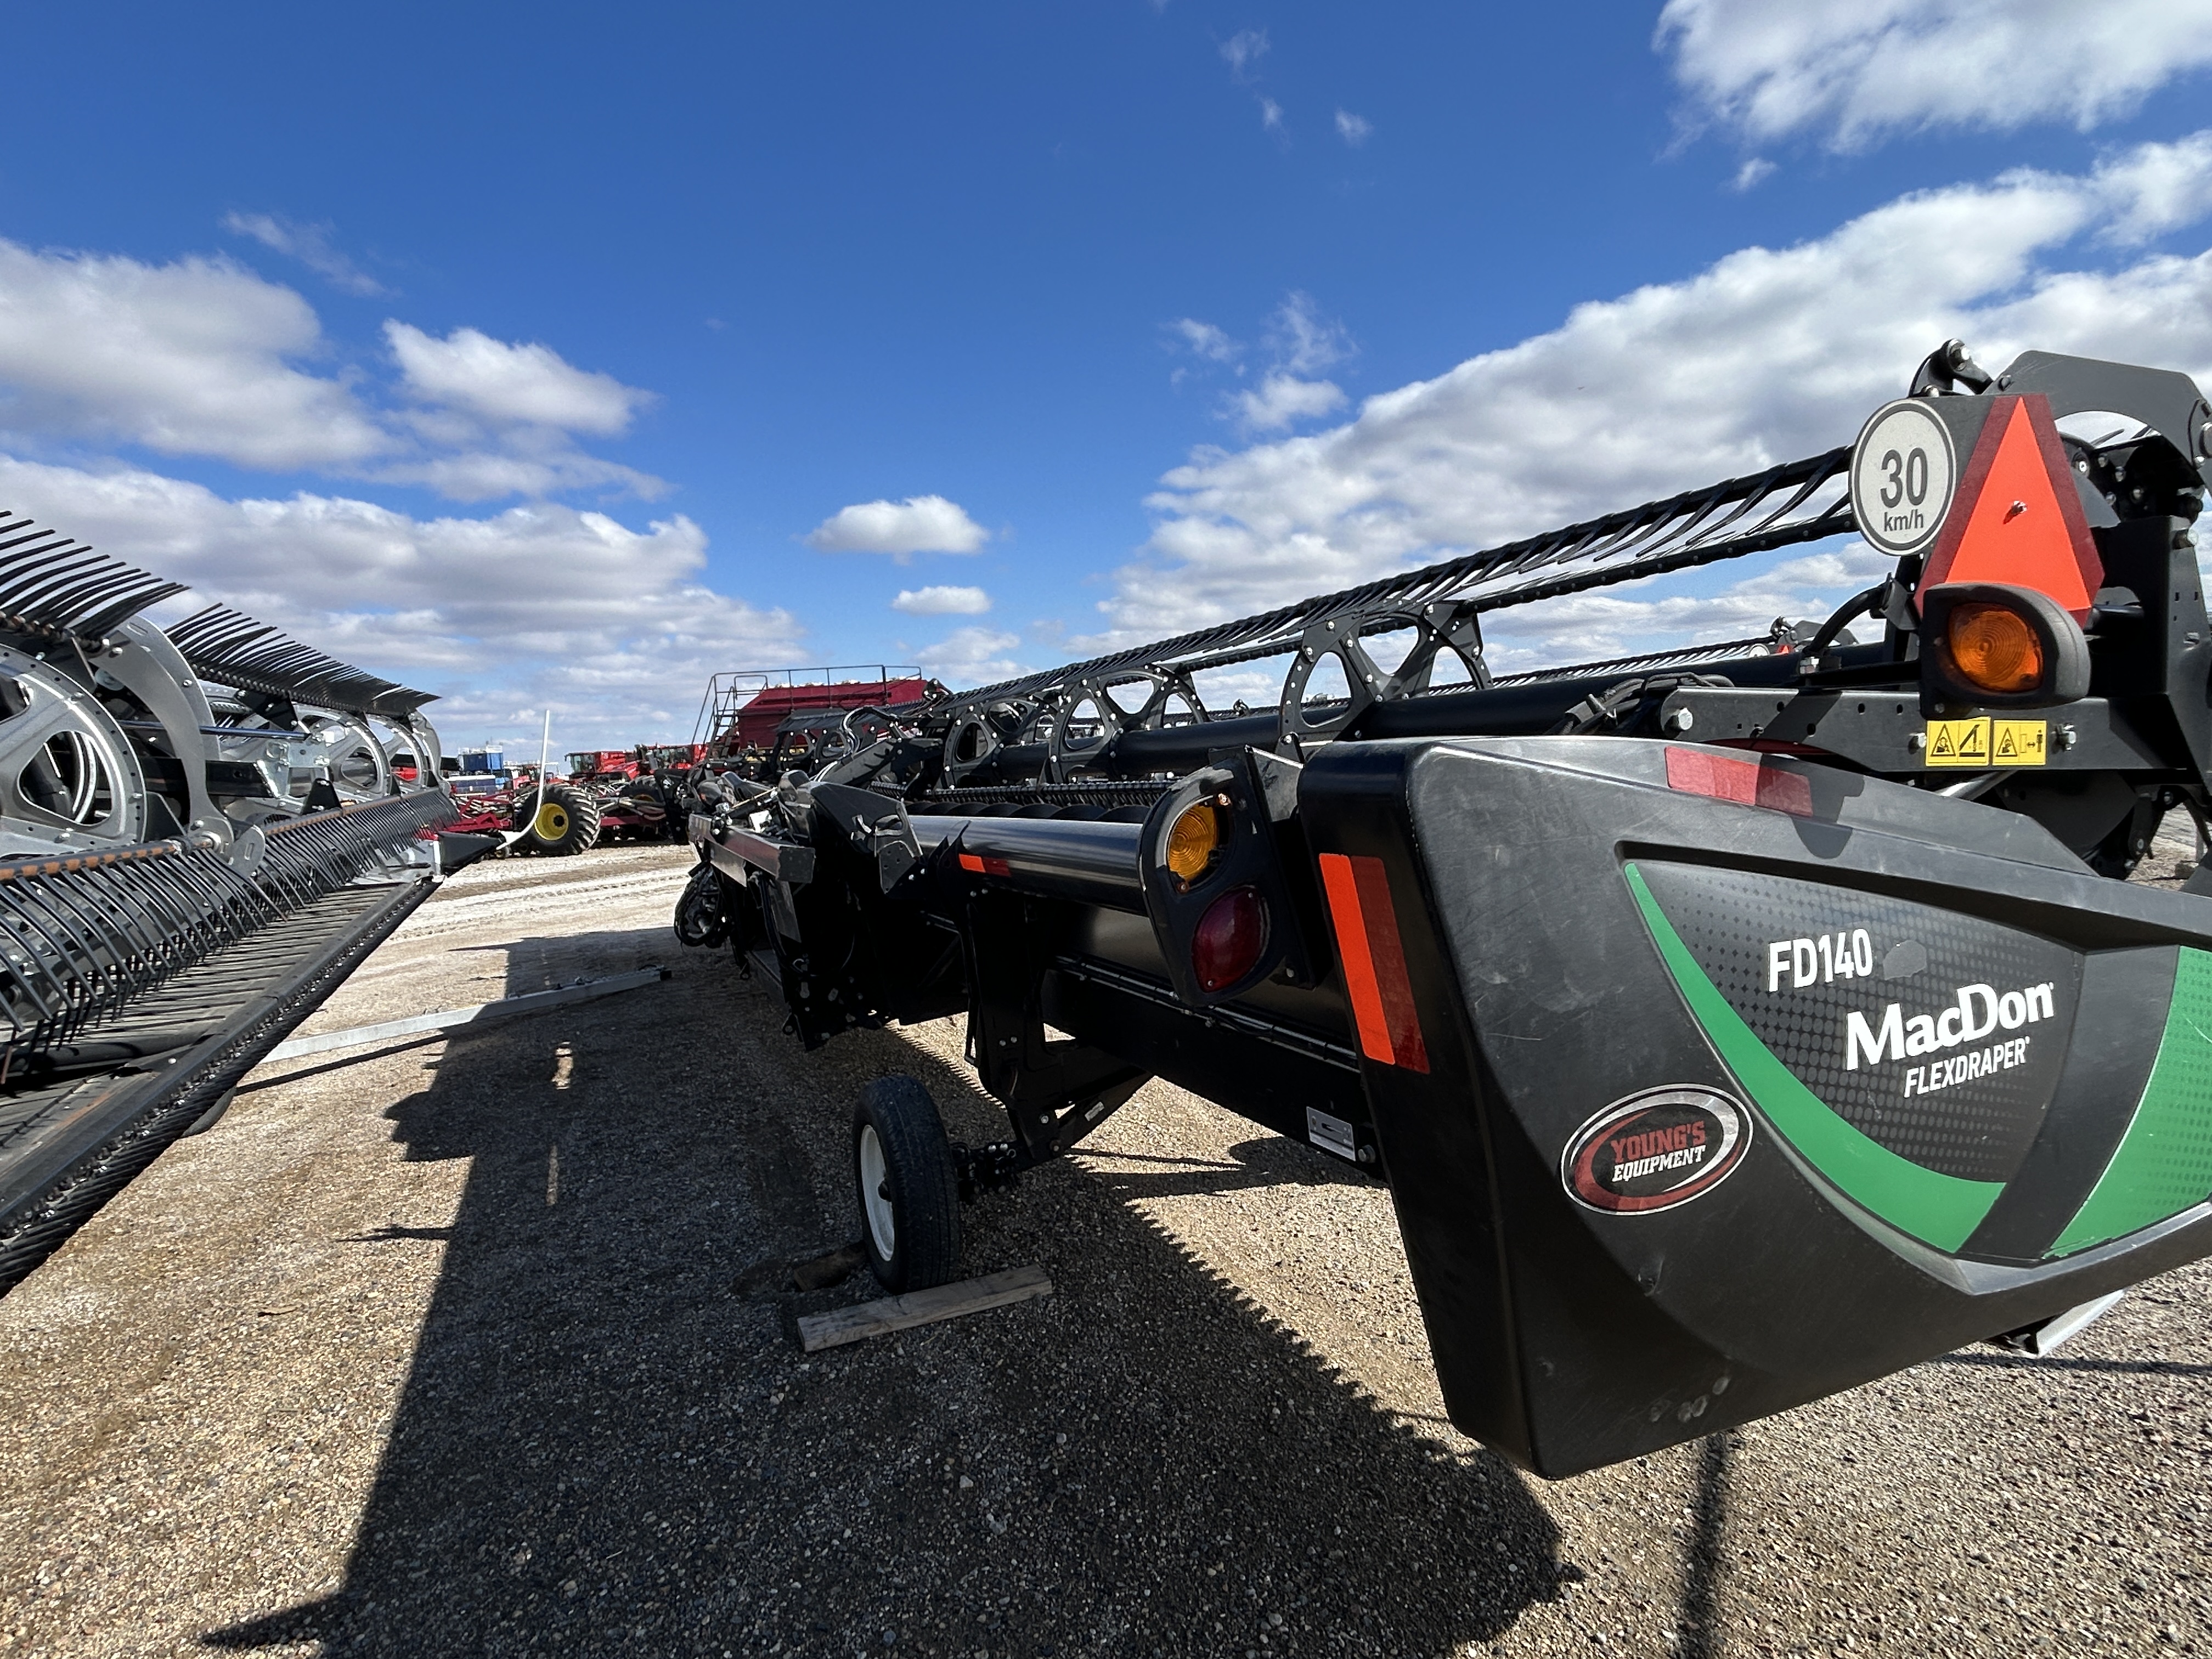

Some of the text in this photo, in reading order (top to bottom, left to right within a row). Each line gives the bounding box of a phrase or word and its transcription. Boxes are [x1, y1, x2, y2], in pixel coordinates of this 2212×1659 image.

[1880, 447, 1928, 508] 30
[1884, 509, 1923, 532] km/h
[1768, 928, 1873, 992] FD140
[1846, 982, 2055, 1071] MacDon
[1904, 1037, 2029, 1098] FLEXDRAPER
[1611, 1120, 1706, 1164] YOUNG'S
[1611, 1144, 1707, 1183] EQUIPMENT
